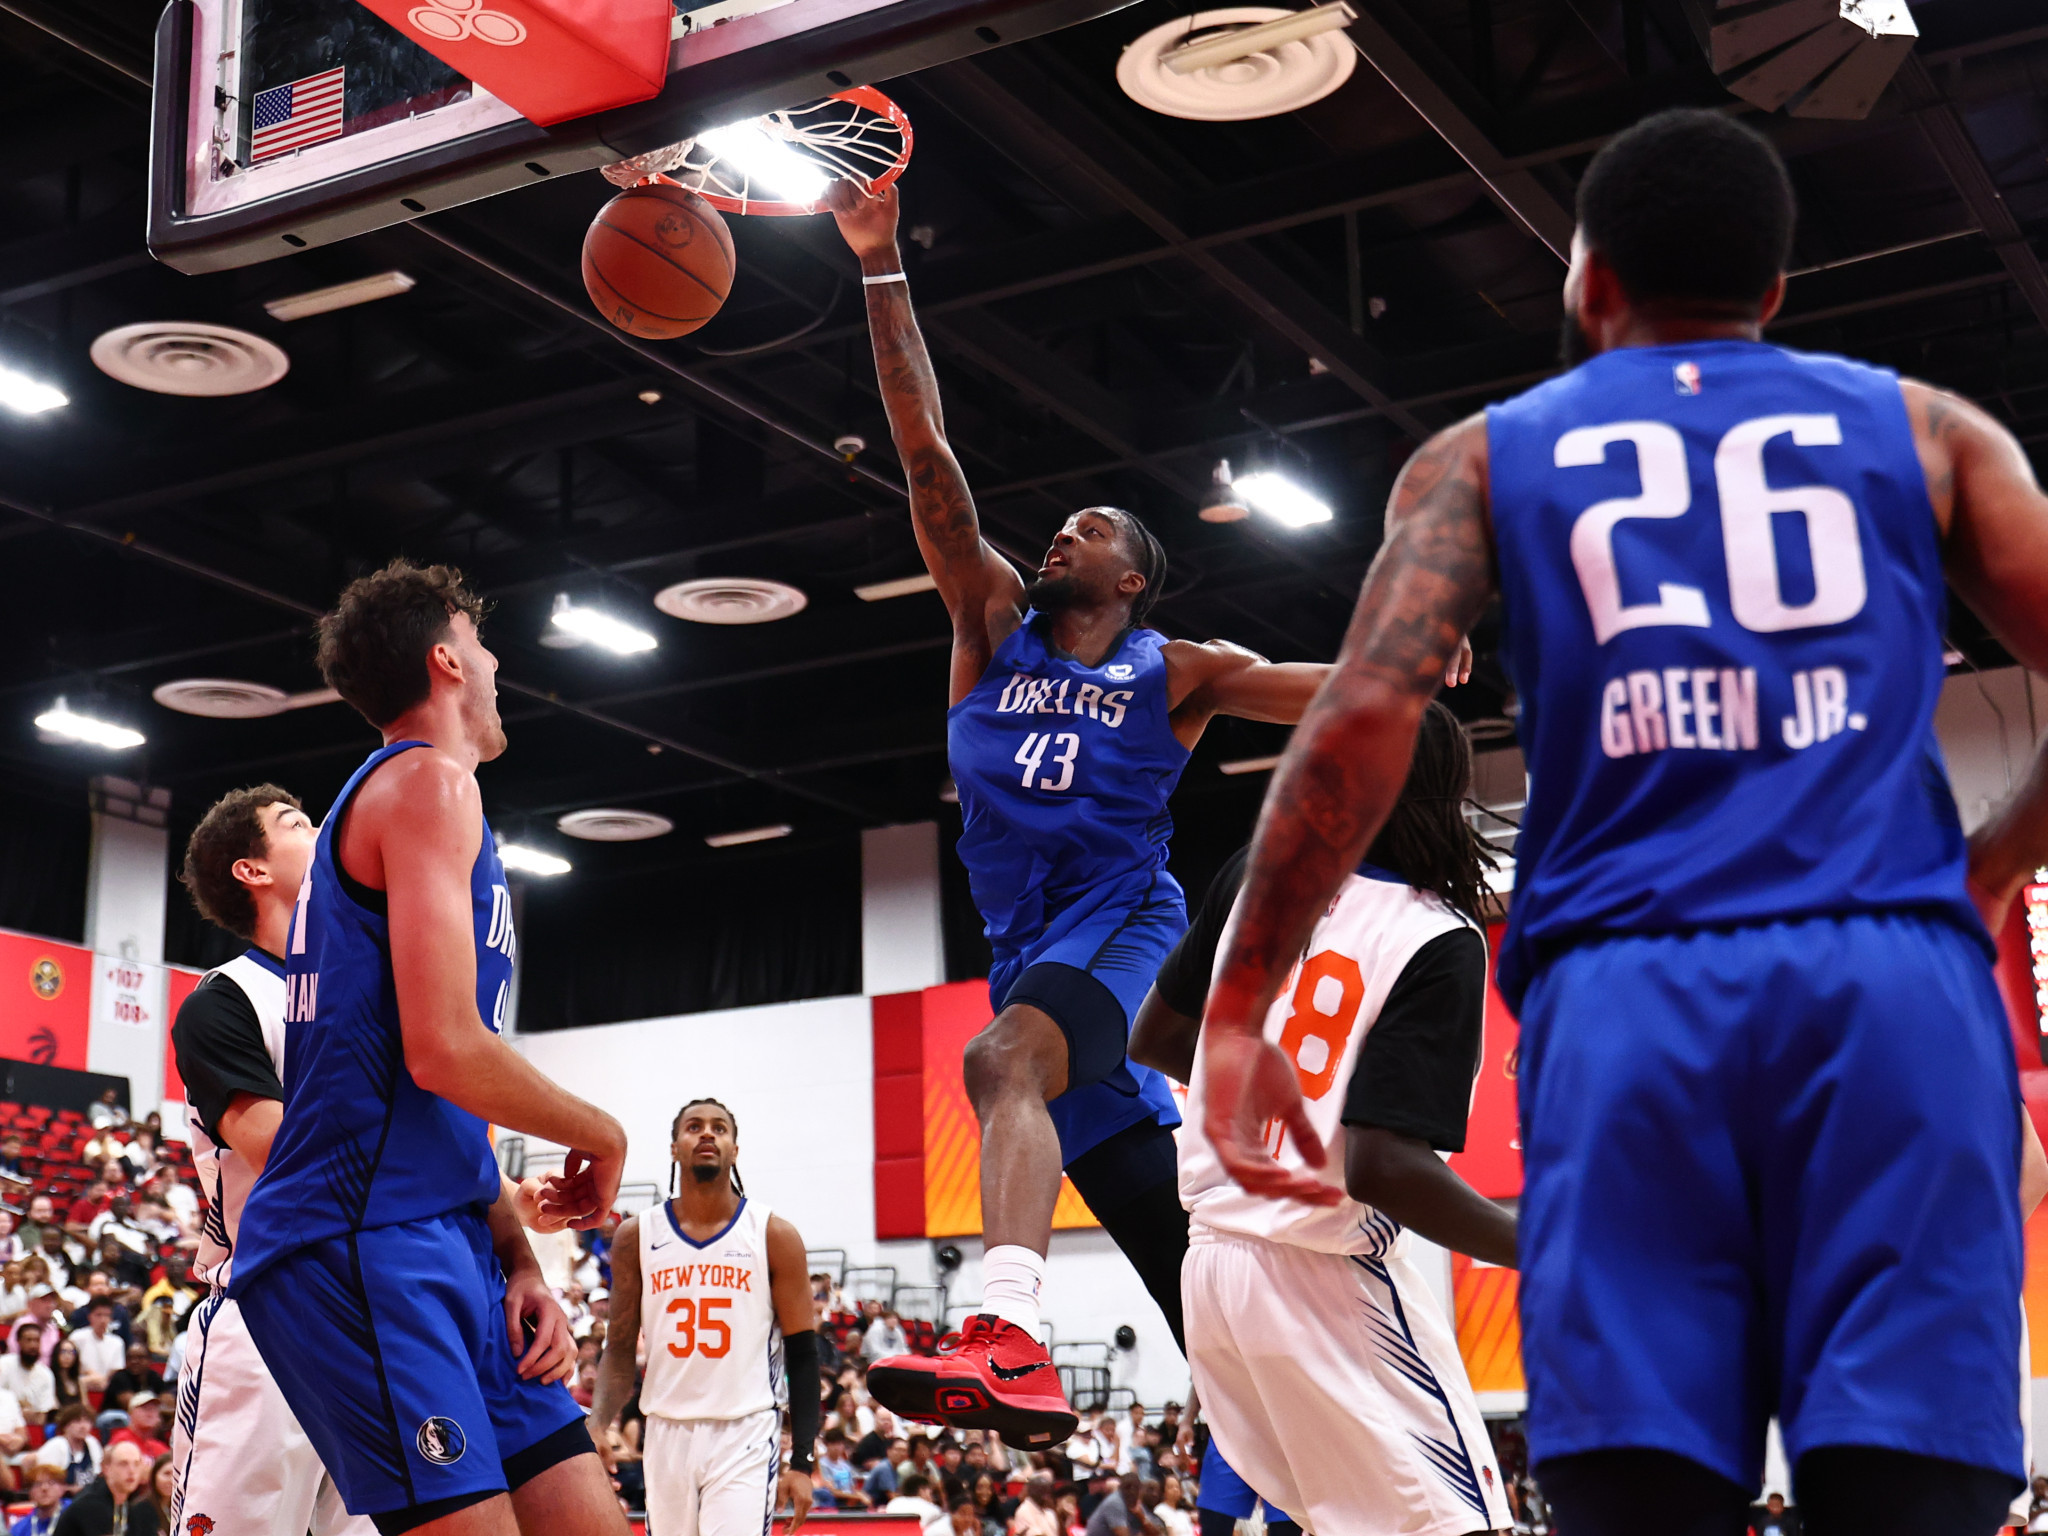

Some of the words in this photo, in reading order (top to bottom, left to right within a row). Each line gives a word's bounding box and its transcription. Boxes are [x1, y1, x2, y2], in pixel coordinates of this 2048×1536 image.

[1553, 413, 1867, 646] 26
[996, 671, 1135, 728] DALLAS
[1601, 667, 1759, 759] GREEN
[1781, 667, 1868, 750] JR.
[1014, 732, 1080, 791] 43
[117, 969, 143, 990] 107
[1276, 949, 1365, 1101] 8
[650, 1264, 695, 1295] NEW
[697, 1264, 752, 1293] YORK
[666, 1297, 732, 1358] 35
